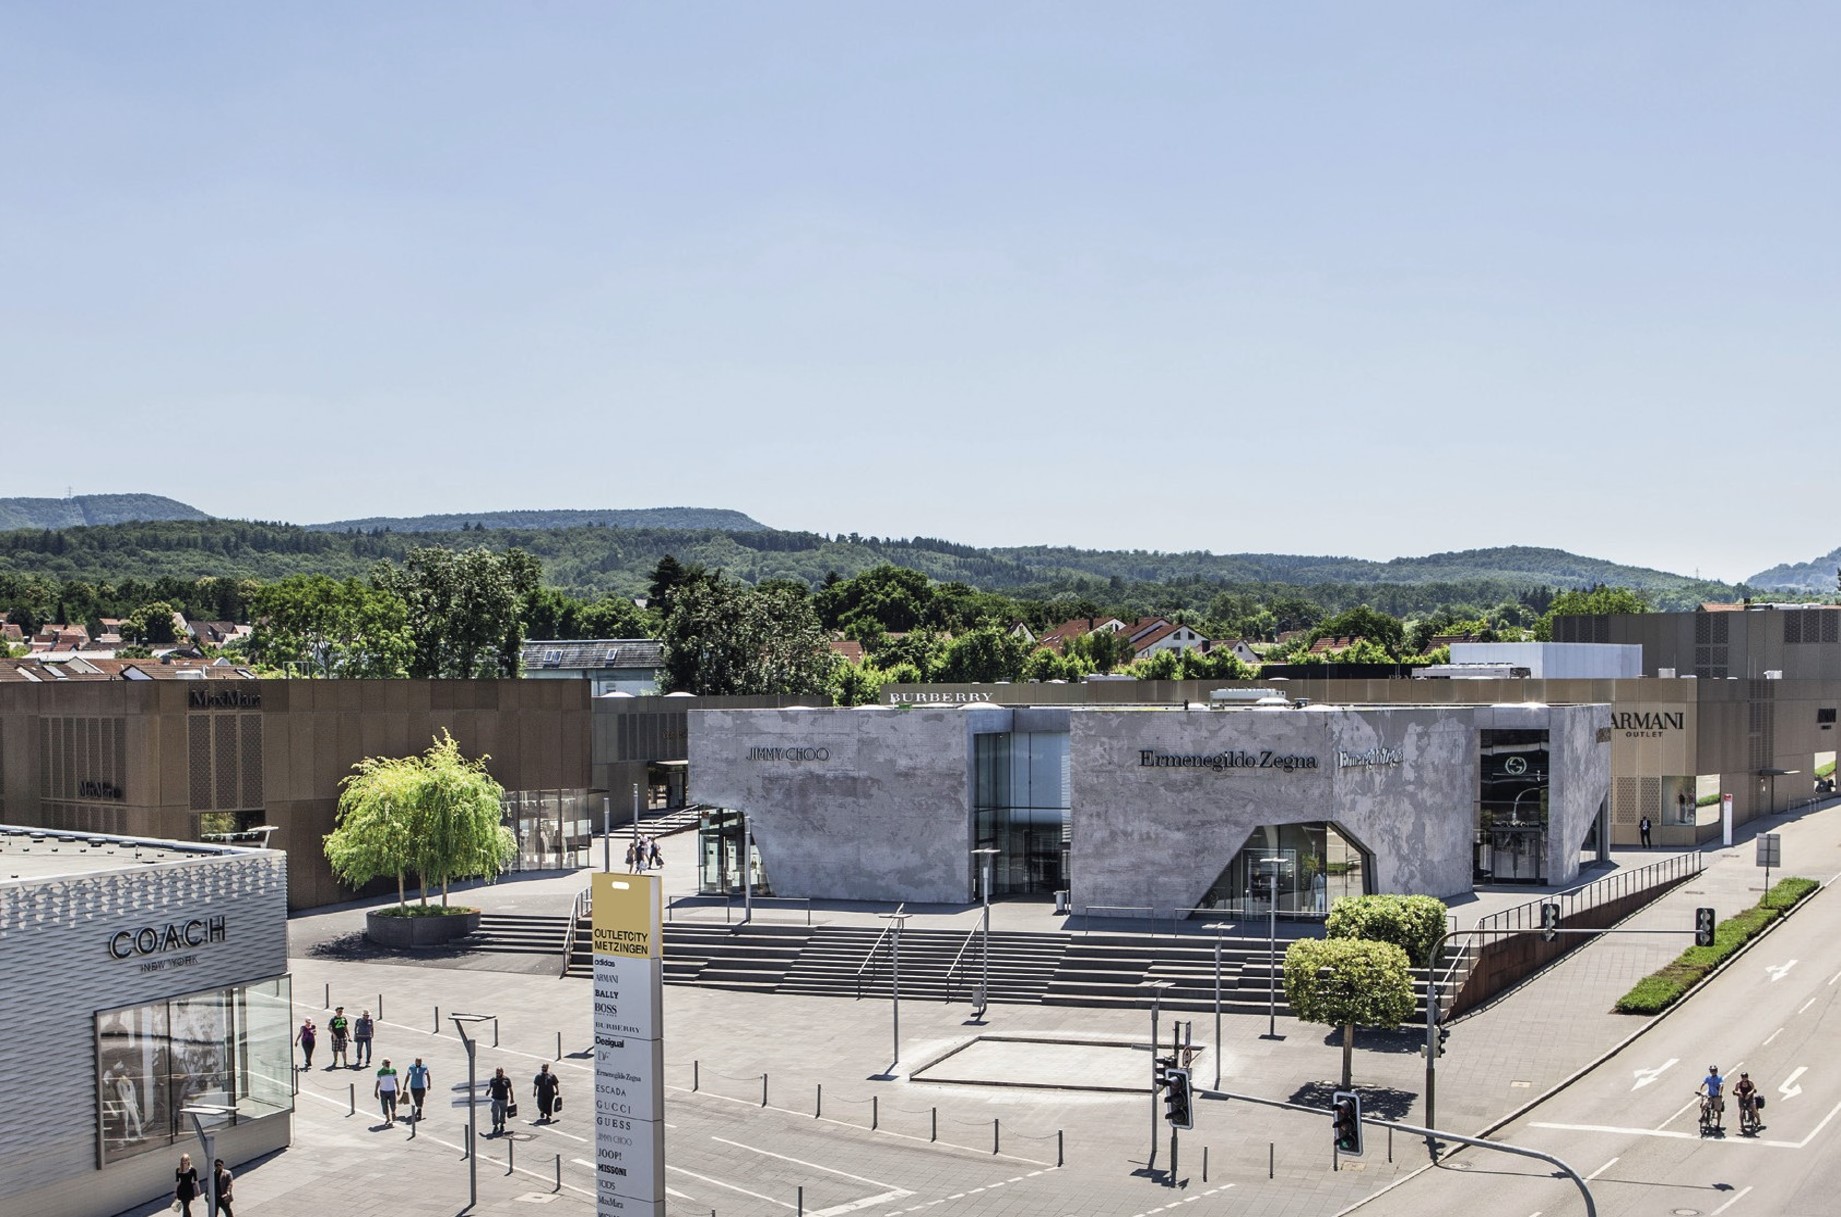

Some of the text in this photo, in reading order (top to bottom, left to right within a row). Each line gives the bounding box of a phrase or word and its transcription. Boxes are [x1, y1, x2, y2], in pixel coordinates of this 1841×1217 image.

[890, 692, 993, 702] BURBERRY
[746, 747, 831, 761] JIMMY CHOO
[1138, 750, 1256, 773] Ermenegildo
[1259, 751, 1318, 773] Zegna
[109, 916, 226, 959] COACH
[594, 928, 648, 942] OUTLETCITY
[594, 941, 648, 955] METZINGEN
[141, 955, 199, 972] NEW YORK
[594, 958, 615, 968] adidas
[595, 973, 619, 984] ARMANI
[594, 989, 619, 999] BALLY
[594, 1002, 618, 1015] BOSS
[595, 1035, 625, 1049] Desigual
[595, 1084, 627, 1097] ESCADA
[596, 1100, 631, 1114] GUCCI
[596, 1117, 631, 1131] GUESS
[597, 1147, 622, 1161] JOOP!
[597, 1163, 627, 1176] MISSONI
